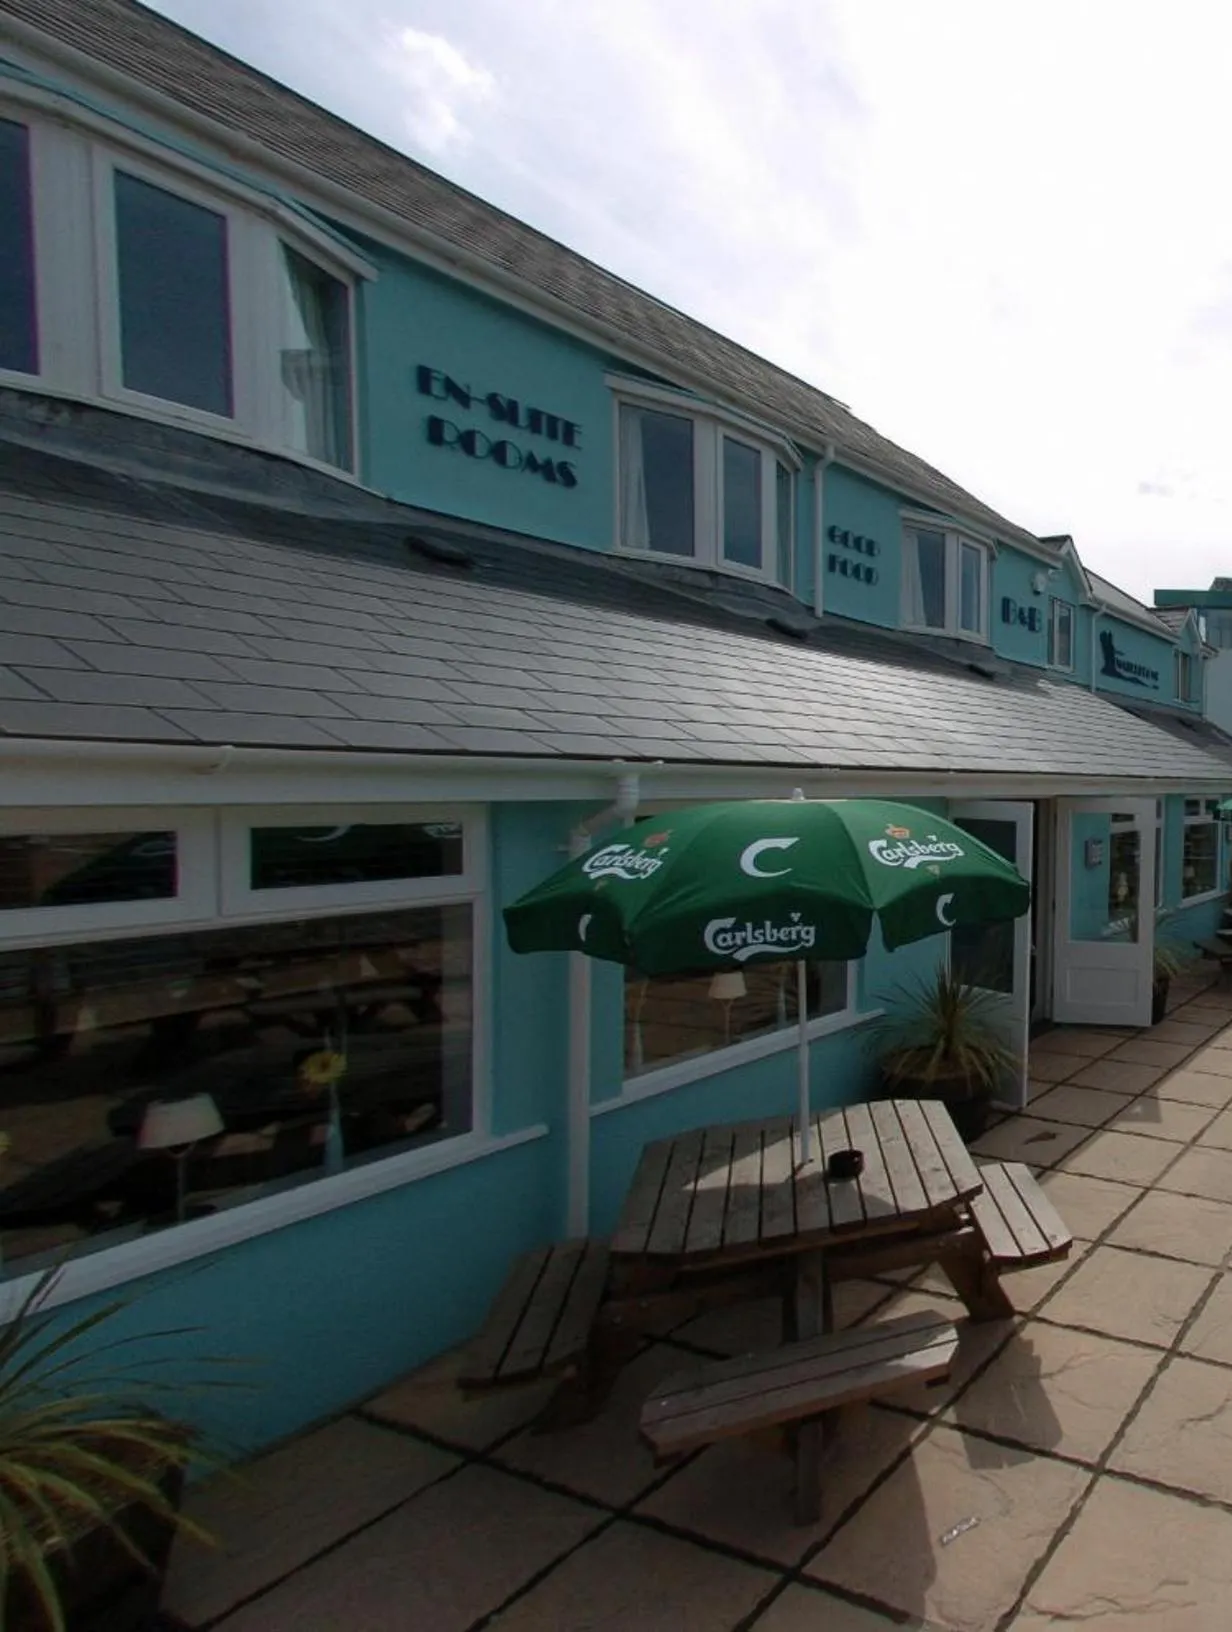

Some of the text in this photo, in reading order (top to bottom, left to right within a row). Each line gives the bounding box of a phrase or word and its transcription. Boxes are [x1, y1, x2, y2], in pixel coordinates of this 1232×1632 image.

[416, 364, 583, 450] EN-SUITE
[427, 415, 578, 489] ROOMS
[828, 525, 881, 557] GOOD
[828, 553, 880, 586] FOOD
[582, 844, 665, 880] Carlsberg
[739, 837, 800, 878] C
[868, 838, 966, 869] Carlsberg
[704, 916, 816, 962] Carlsberg
